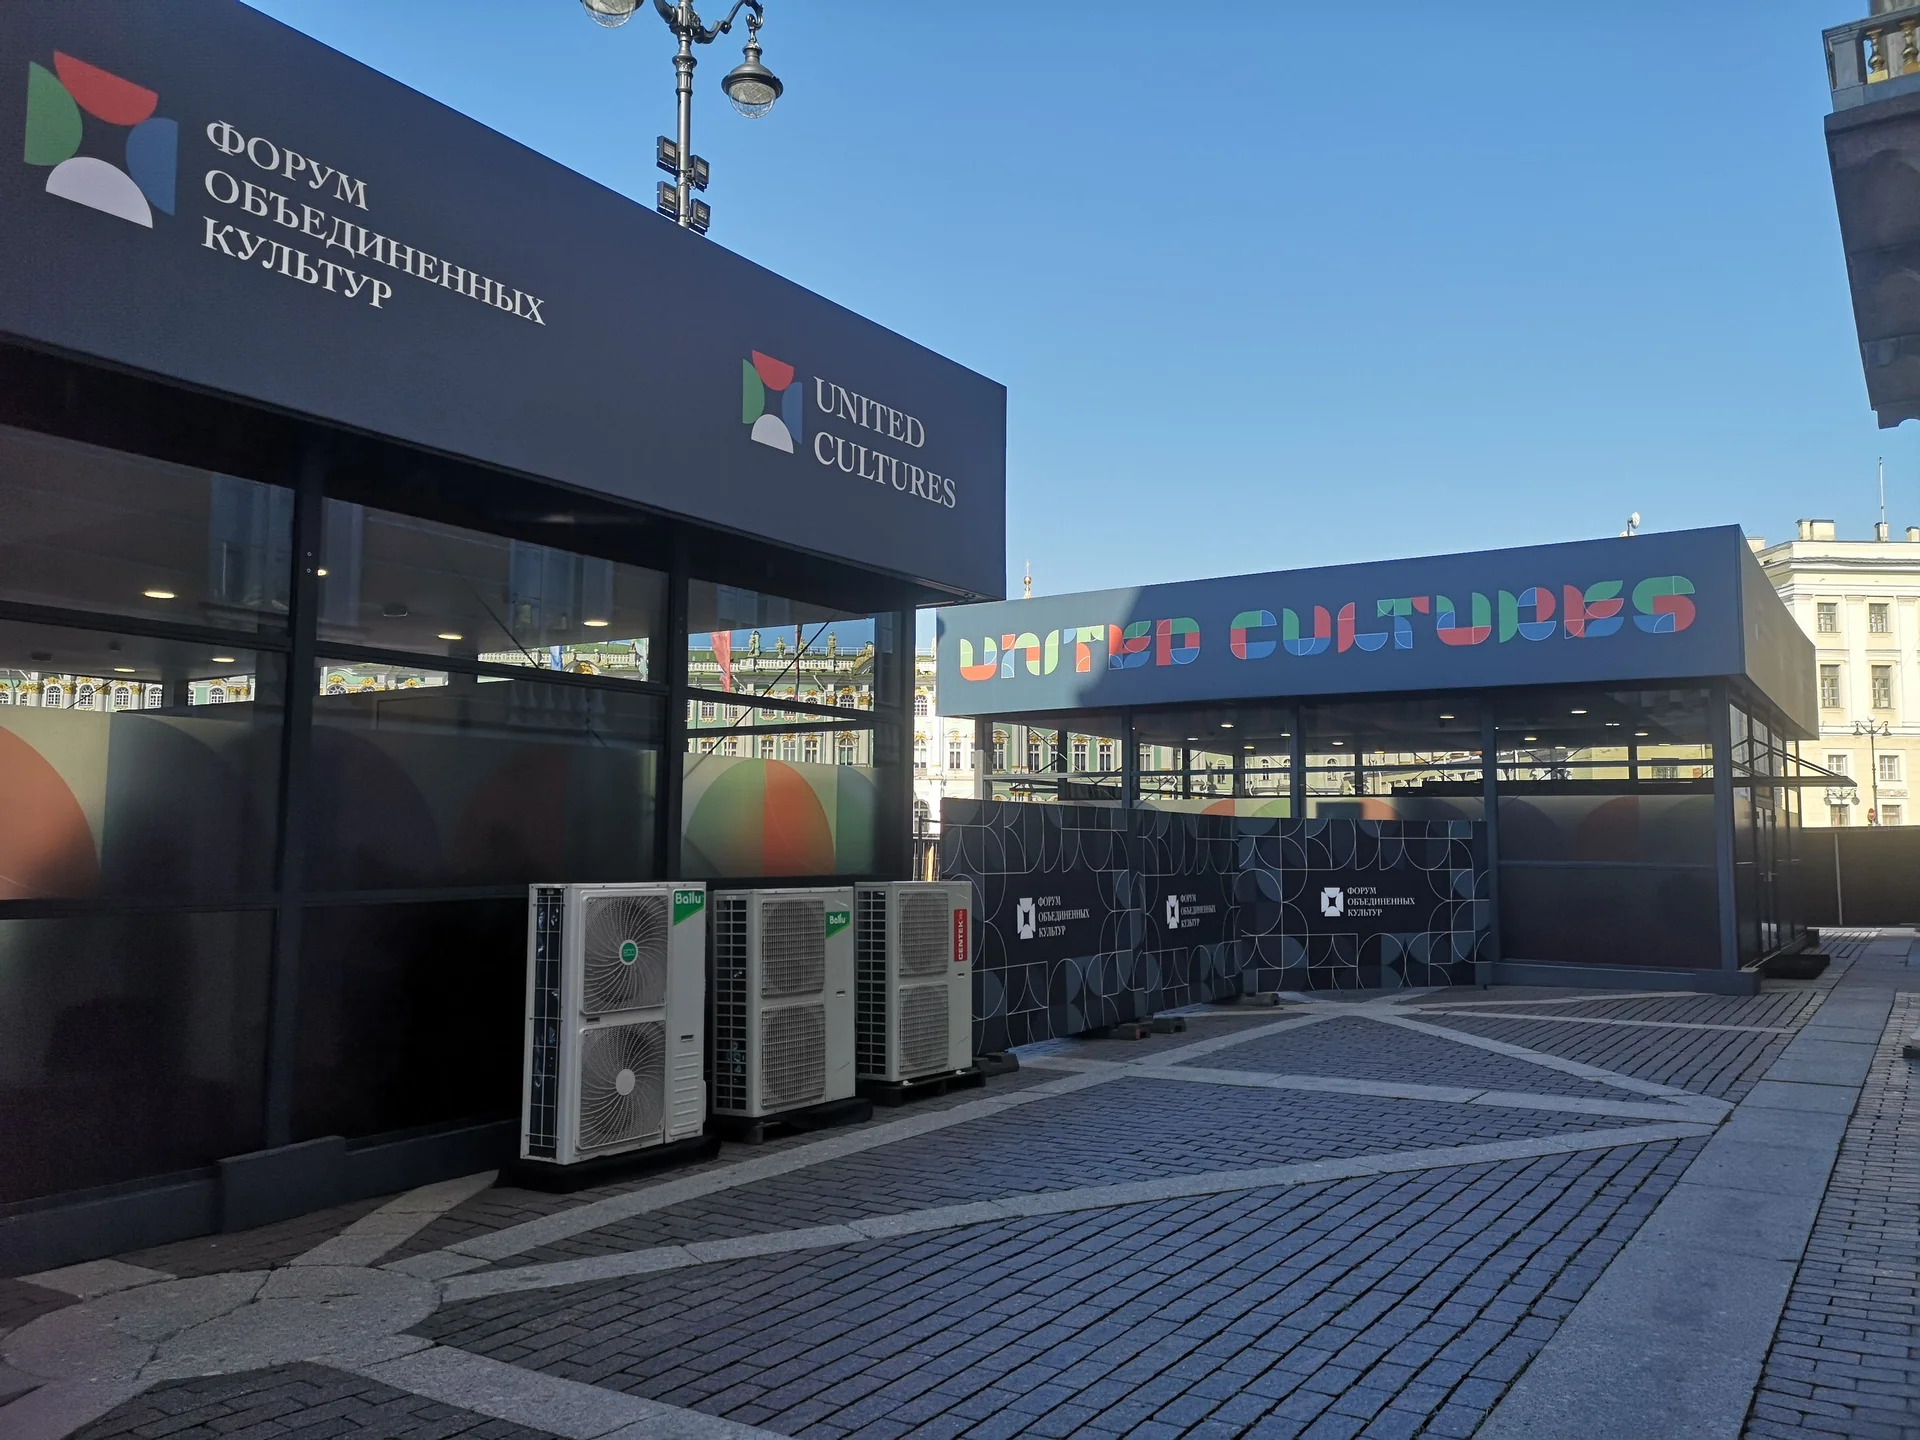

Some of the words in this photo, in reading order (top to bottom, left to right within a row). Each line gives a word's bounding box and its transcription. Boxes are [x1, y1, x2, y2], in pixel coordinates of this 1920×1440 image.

[206, 119, 370, 211] ФОРУМ
[204, 169, 546, 326] ОБЪЕДИНЕННЫХ
[201, 216, 393, 310] КУЛЬТУР
[813, 375, 926, 449] UNITED
[814, 431, 957, 509] CULTURES
[1229, 575, 1697, 660] CULTURES
[1347, 886, 1377, 895] ФОРУМ
[675, 891, 702, 905] Ballu
[1037, 895, 1062, 907] ФОРУМ
[1347, 897, 1415, 906] ОБЪЕДИНЕННЫХ
[829, 913, 846, 925] Ballu
[1038, 908, 1090, 923] ОБЪЕДИНЕННЫХ
[1347, 908, 1383, 917] КУЛЬТУР
[1038, 925, 1067, 938] КУЛЬТУР
